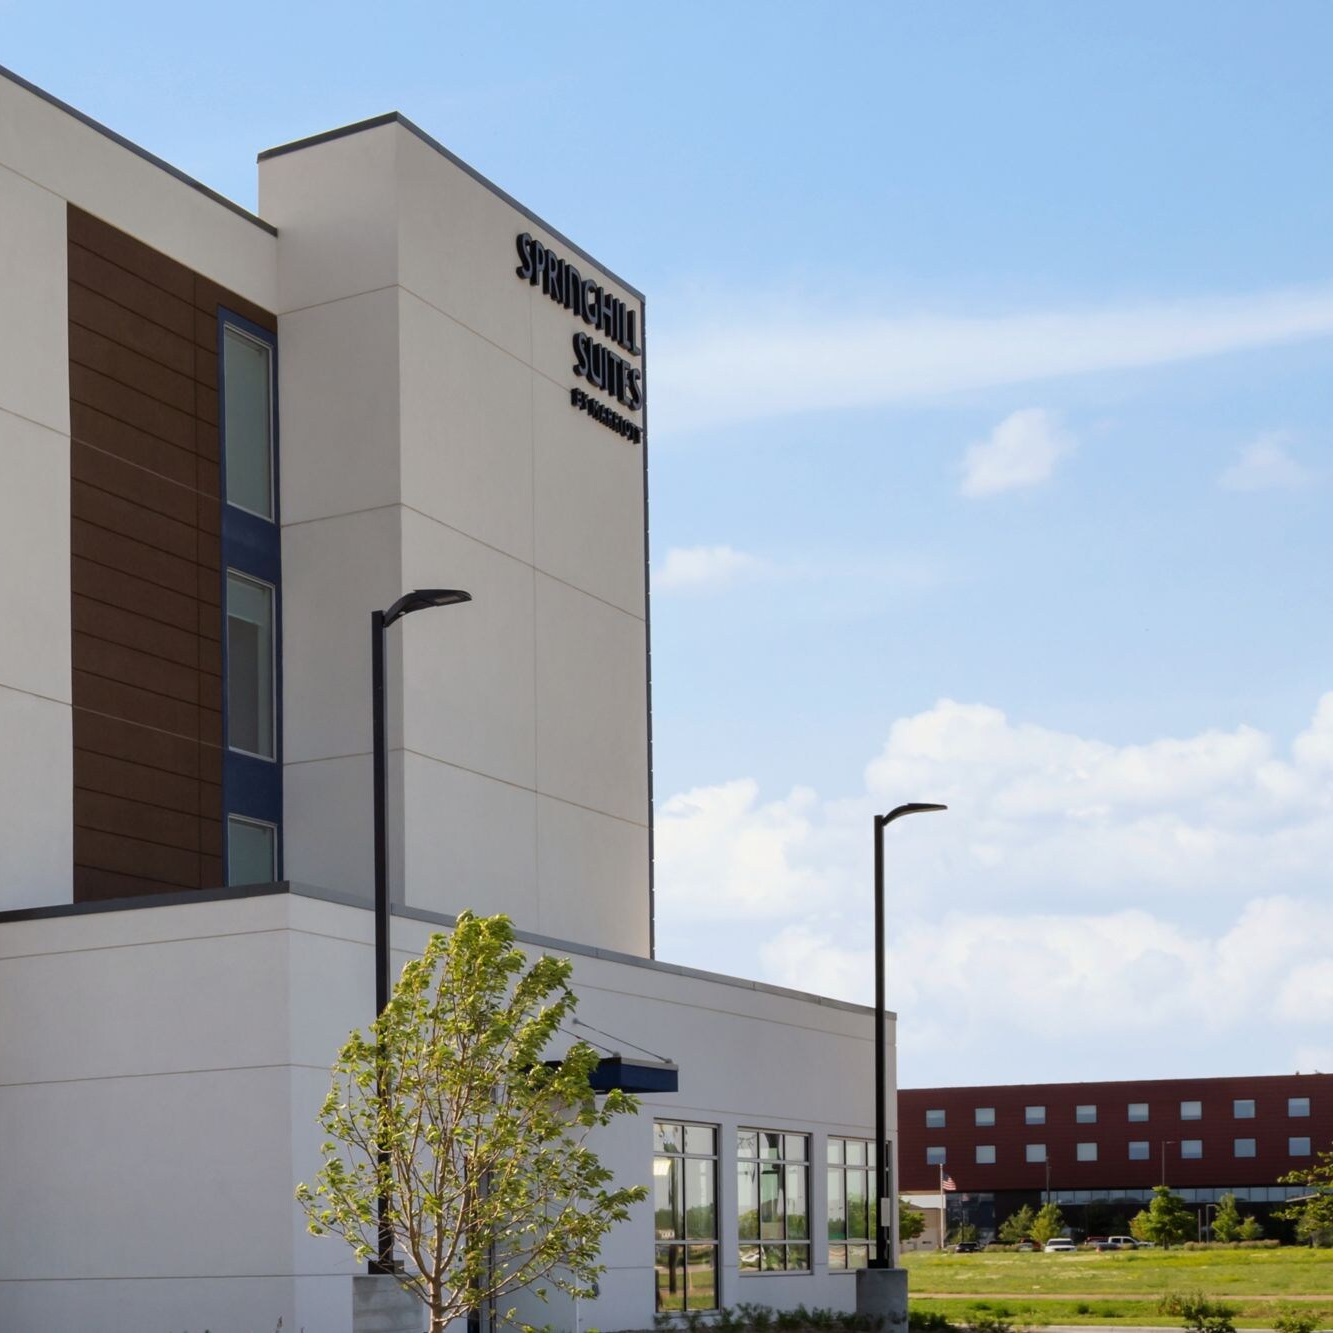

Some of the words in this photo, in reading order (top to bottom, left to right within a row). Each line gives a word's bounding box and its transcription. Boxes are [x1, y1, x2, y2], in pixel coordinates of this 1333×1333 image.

[517, 232, 641, 355] SPRINGHILL
[570, 388, 589, 411] BY
[573, 332, 642, 411] SUITES
